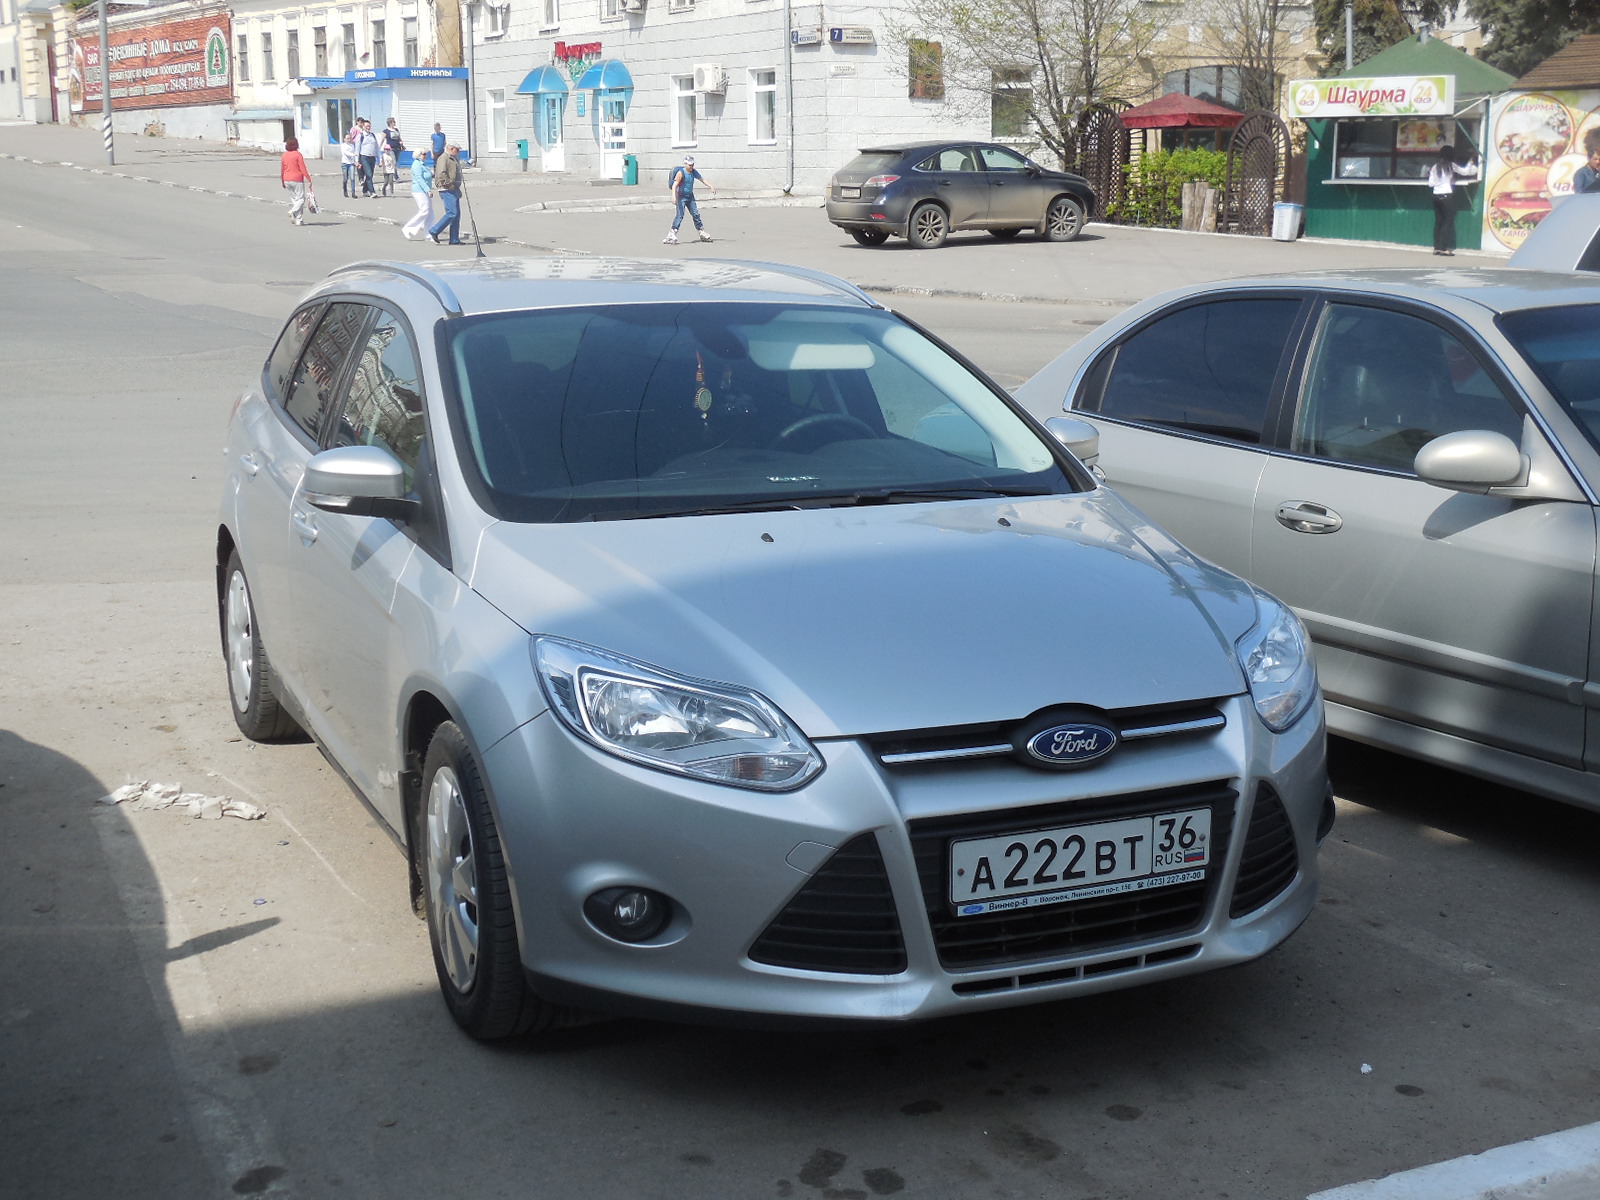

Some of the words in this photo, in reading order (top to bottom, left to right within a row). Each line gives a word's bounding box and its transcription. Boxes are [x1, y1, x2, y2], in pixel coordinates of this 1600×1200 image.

[833, 30, 839, 40] 7
[150, 39, 171, 59] ДОМА
[410, 69, 453, 77] ЖУРНАЛЫ
[1300, 89, 1315, 101] 24
[1327, 86, 1406, 113] Шаурма
[1416, 86, 1433, 99] 24
[1513, 103, 1555, 112] ШАУРМА
[1556, 161, 1575, 183] 2
[1051, 730, 1098, 755] Ford
[1159, 816, 1197, 852] 36
[1155, 852, 1183, 867] RUS
[1146, 876, 1165, 888] (473)
[1166, 871, 1201, 884] 227-97-00
